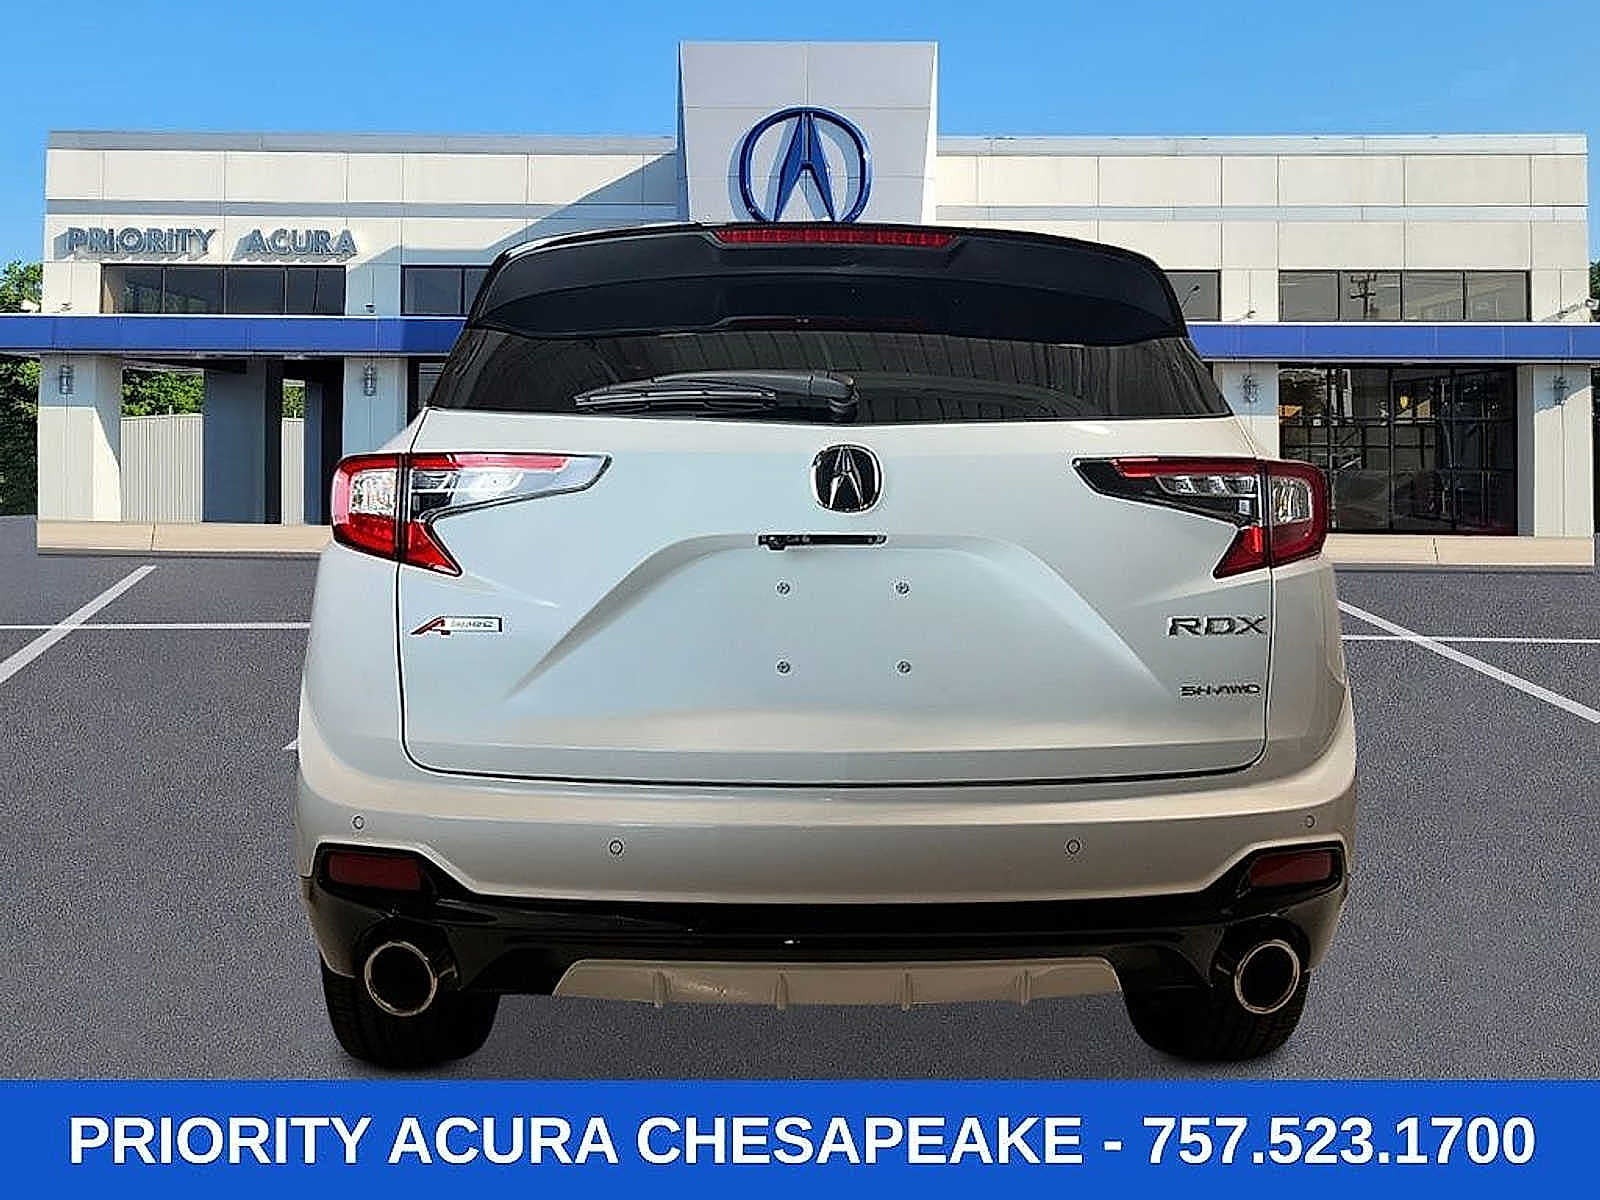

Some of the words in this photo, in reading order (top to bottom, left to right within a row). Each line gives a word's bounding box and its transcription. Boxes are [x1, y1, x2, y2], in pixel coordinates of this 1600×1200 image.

[66, 227, 216, 252] PRIORITY
[249, 228, 358, 254] ACURA
[1168, 616, 1267, 636] RDX
